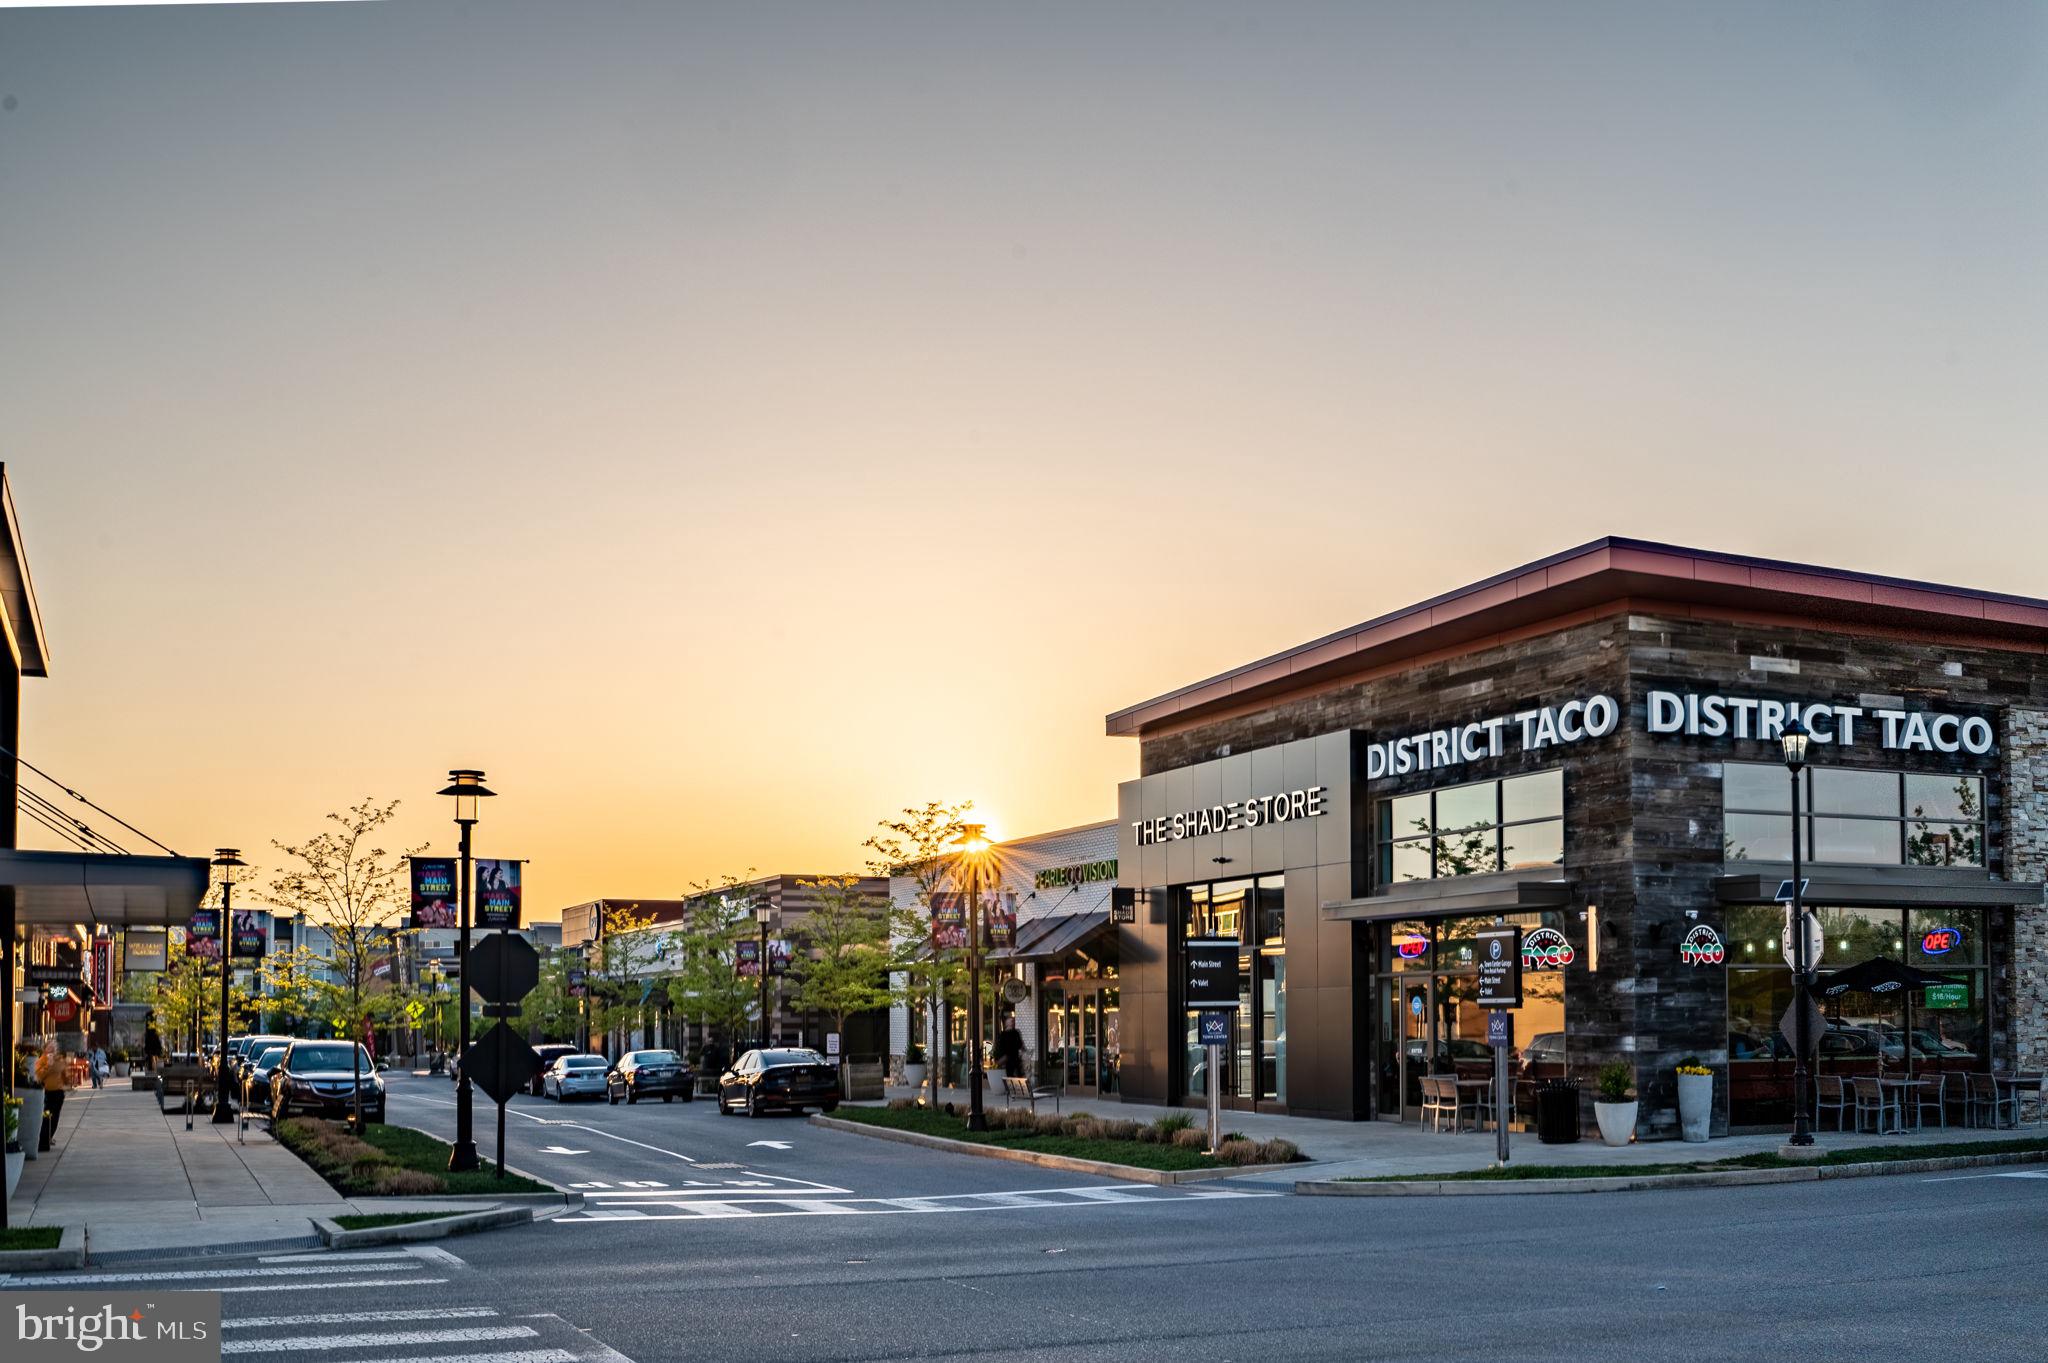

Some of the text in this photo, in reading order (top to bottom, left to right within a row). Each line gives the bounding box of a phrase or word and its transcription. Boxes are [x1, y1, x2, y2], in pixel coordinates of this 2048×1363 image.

[1648, 691, 1993, 755] DISTRICT TACO
[1368, 694, 1619, 780] DISTRICT TACO
[1132, 786, 1324, 846] THE SHADE STORE
[1034, 860, 1115, 890] PEARLE VISION
[1529, 932, 1562, 947] DISTRICT
[1689, 929, 1715, 943] DISTRICT
[1925, 932, 1954, 949] OPE
[1198, 960, 1221, 968] Main Street
[1521, 945, 1574, 970] TACO
[1680, 942, 1724, 967] TACO
